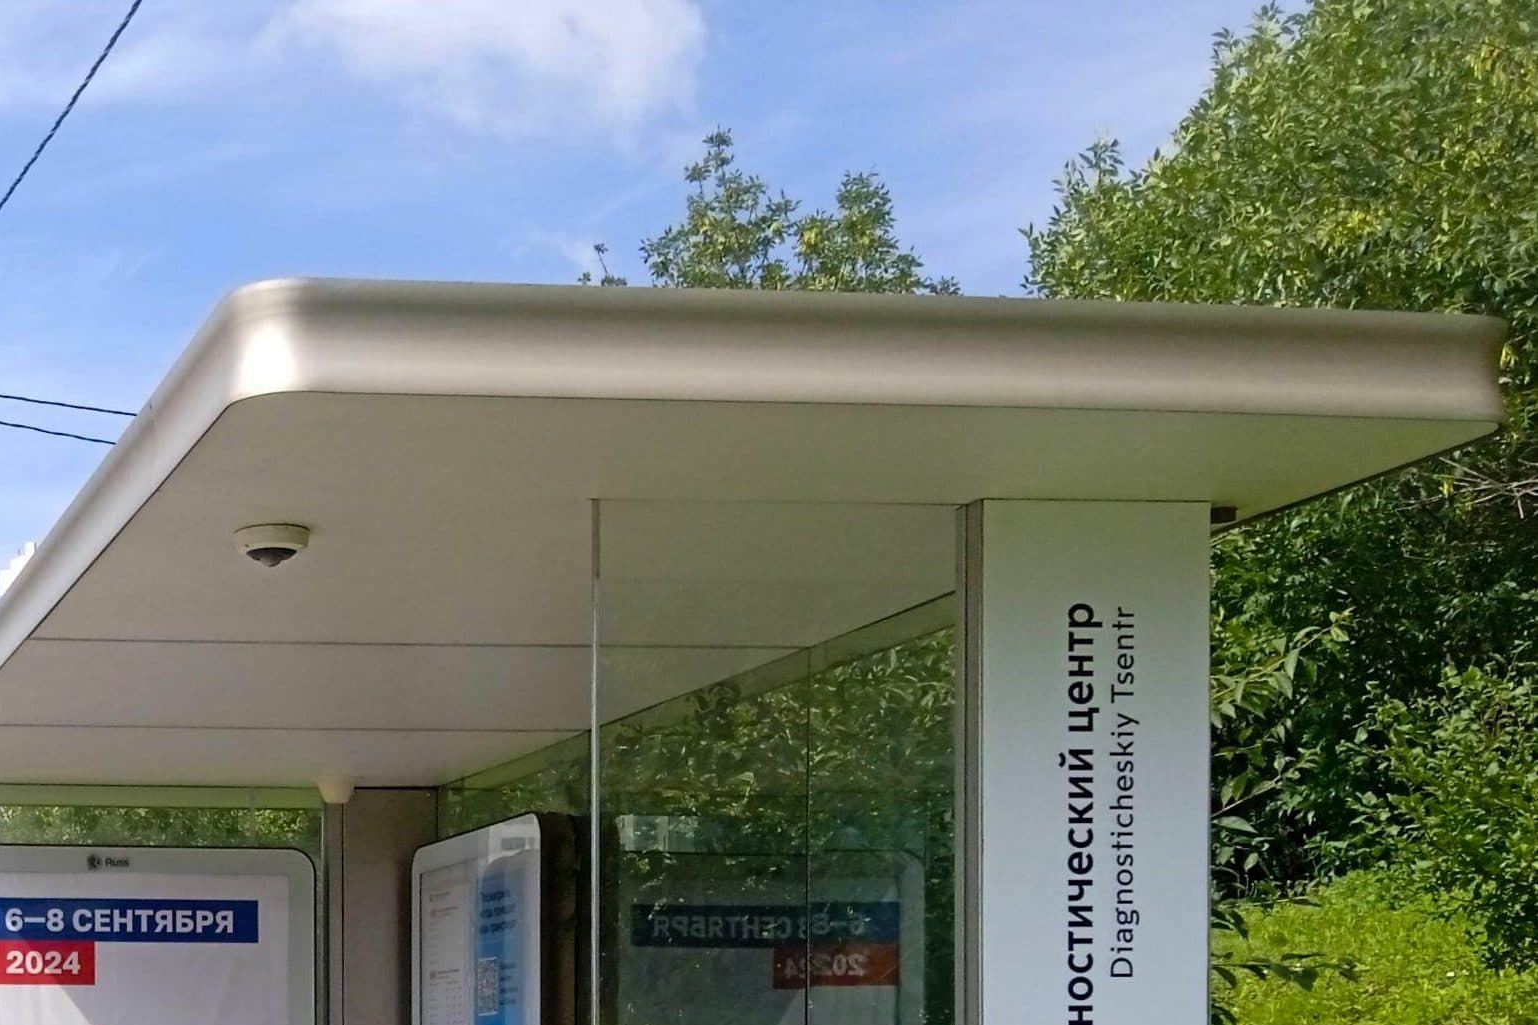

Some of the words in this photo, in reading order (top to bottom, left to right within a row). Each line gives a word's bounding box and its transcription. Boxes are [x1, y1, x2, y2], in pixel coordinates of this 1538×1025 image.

[1067, 602, 1103, 733] центр
[1110, 607, 1136, 703] Tsentr
[1109, 713, 1140, 978] Diagnosticheskiy
[5, 950, 81, 975] 2024
[72, 909, 234, 934] СЕНТЯБРЯ
